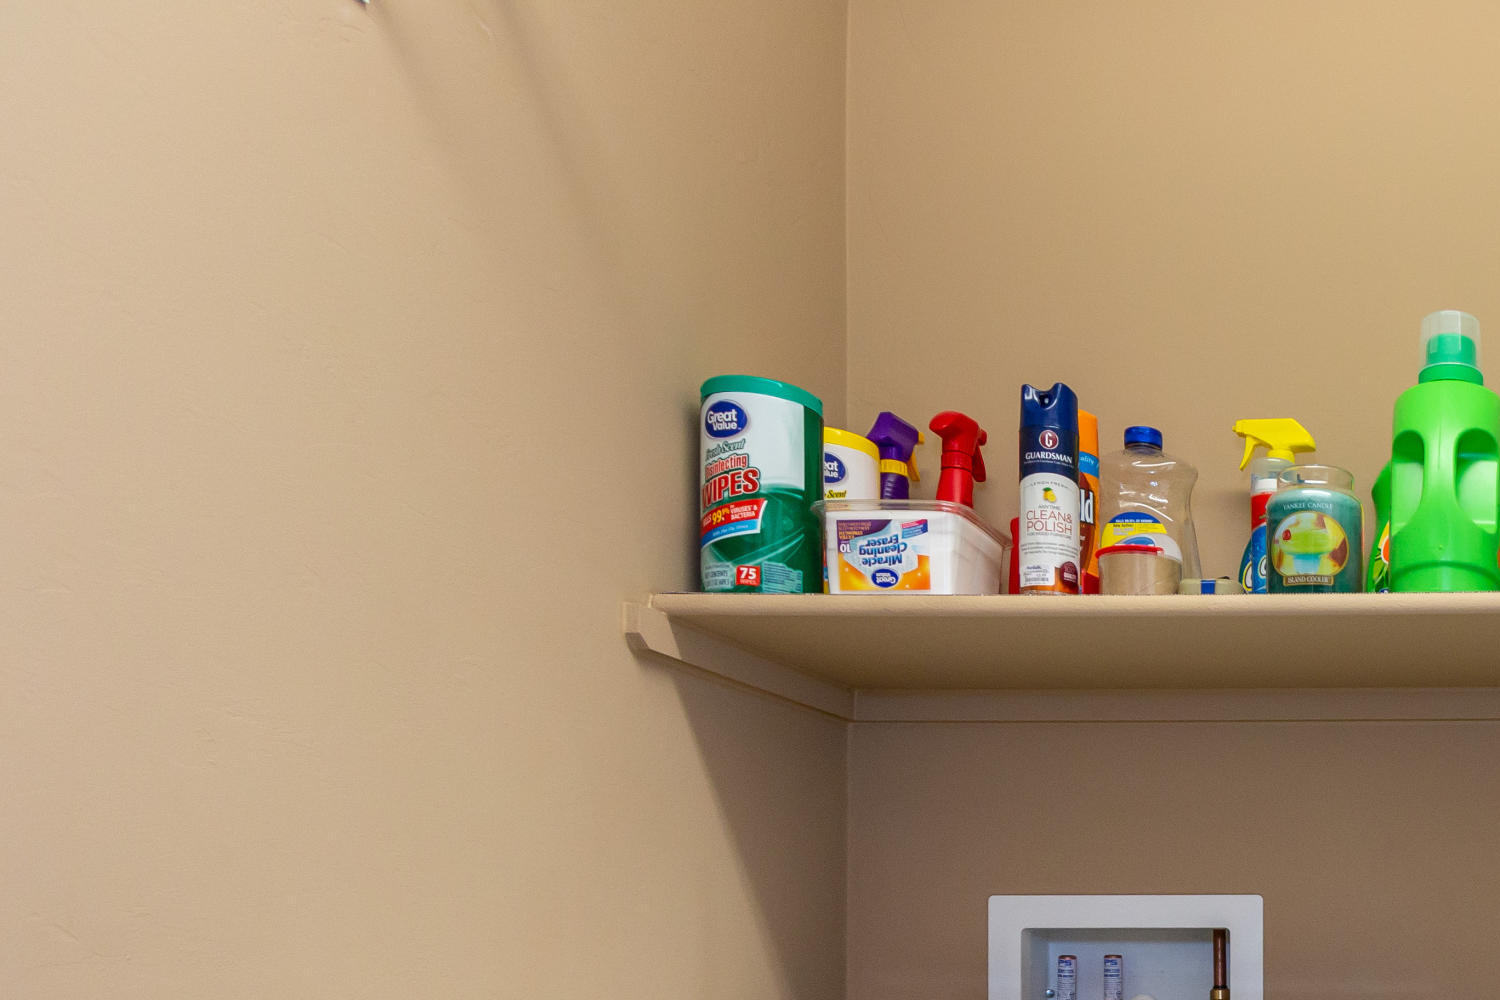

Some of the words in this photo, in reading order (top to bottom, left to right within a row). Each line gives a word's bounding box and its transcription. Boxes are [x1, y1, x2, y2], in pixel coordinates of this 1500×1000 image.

[707, 408, 737, 423] Great
[712, 420, 738, 431] Value
[721, 438, 746, 453] Scent
[1025, 451, 1072, 464] GUARDSMAN
[1080, 456, 1094, 465] ality
[705, 454, 748, 478] Disinfecting
[824, 460, 838, 471] eat
[702, 467, 761, 508] WIPES
[827, 489, 847, 499] Scent
[1283, 503, 1306, 511] YANKEE
[1307, 502, 1333, 510] CANDLE
[1026, 520, 1072, 536] POLISH
[865, 534, 899, 547] Eraser
[840, 543, 851, 553] 10
[859, 542, 907, 555] Cleaning
[862, 555, 903, 567] Miracle
[740, 567, 757, 580] 75
[876, 575, 896, 584] Great
[1306, 576, 1329, 584] COOLER
